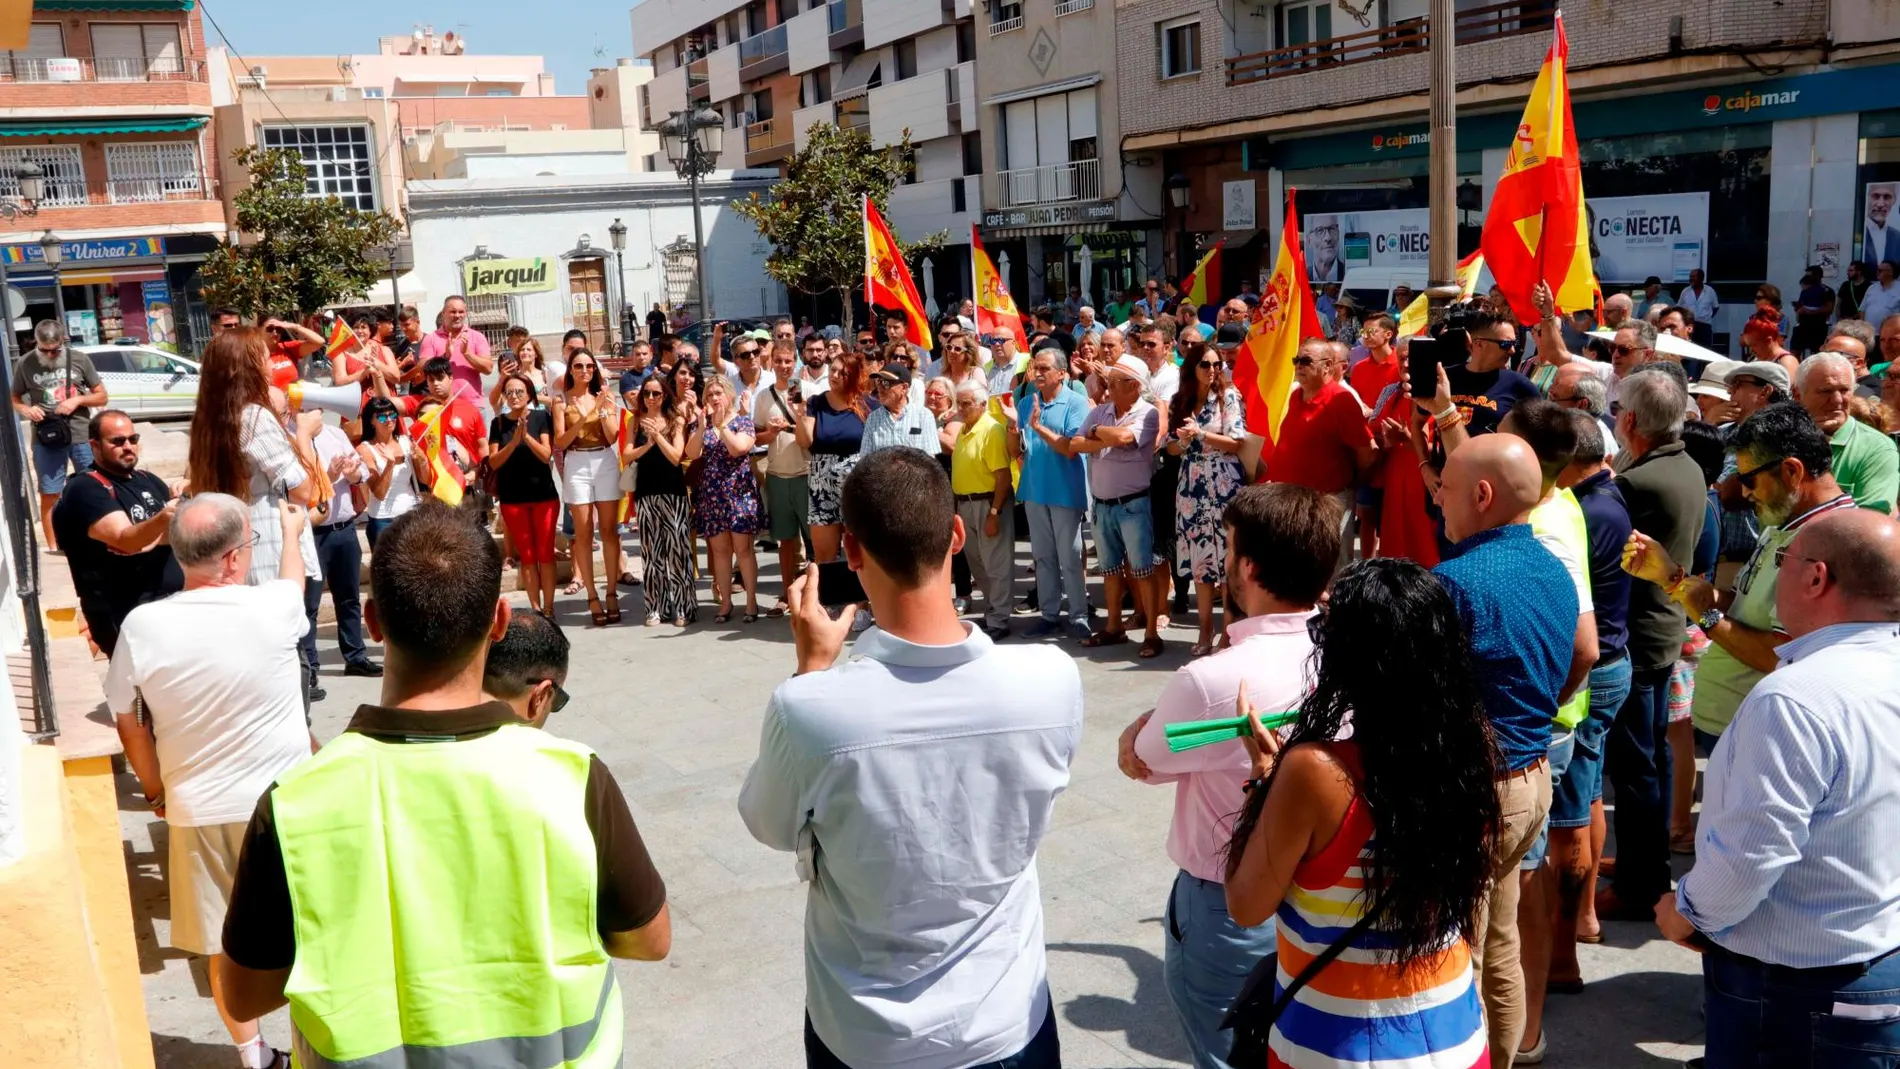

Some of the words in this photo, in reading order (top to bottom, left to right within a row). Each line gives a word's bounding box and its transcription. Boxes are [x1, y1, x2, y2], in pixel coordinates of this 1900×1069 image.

[1725, 88, 1800, 112] cajamar
[986, 211, 1004, 226] CAFÉ
[1010, 212, 1026, 225] BAR
[1029, 207, 1051, 224] JUAN
[1599, 215, 1682, 237] CONECTA
[72, 242, 125, 260] Unirea
[127, 242, 137, 257] 2
[1376, 232, 1430, 254] CONEC
[469, 257, 546, 291] jarquil
